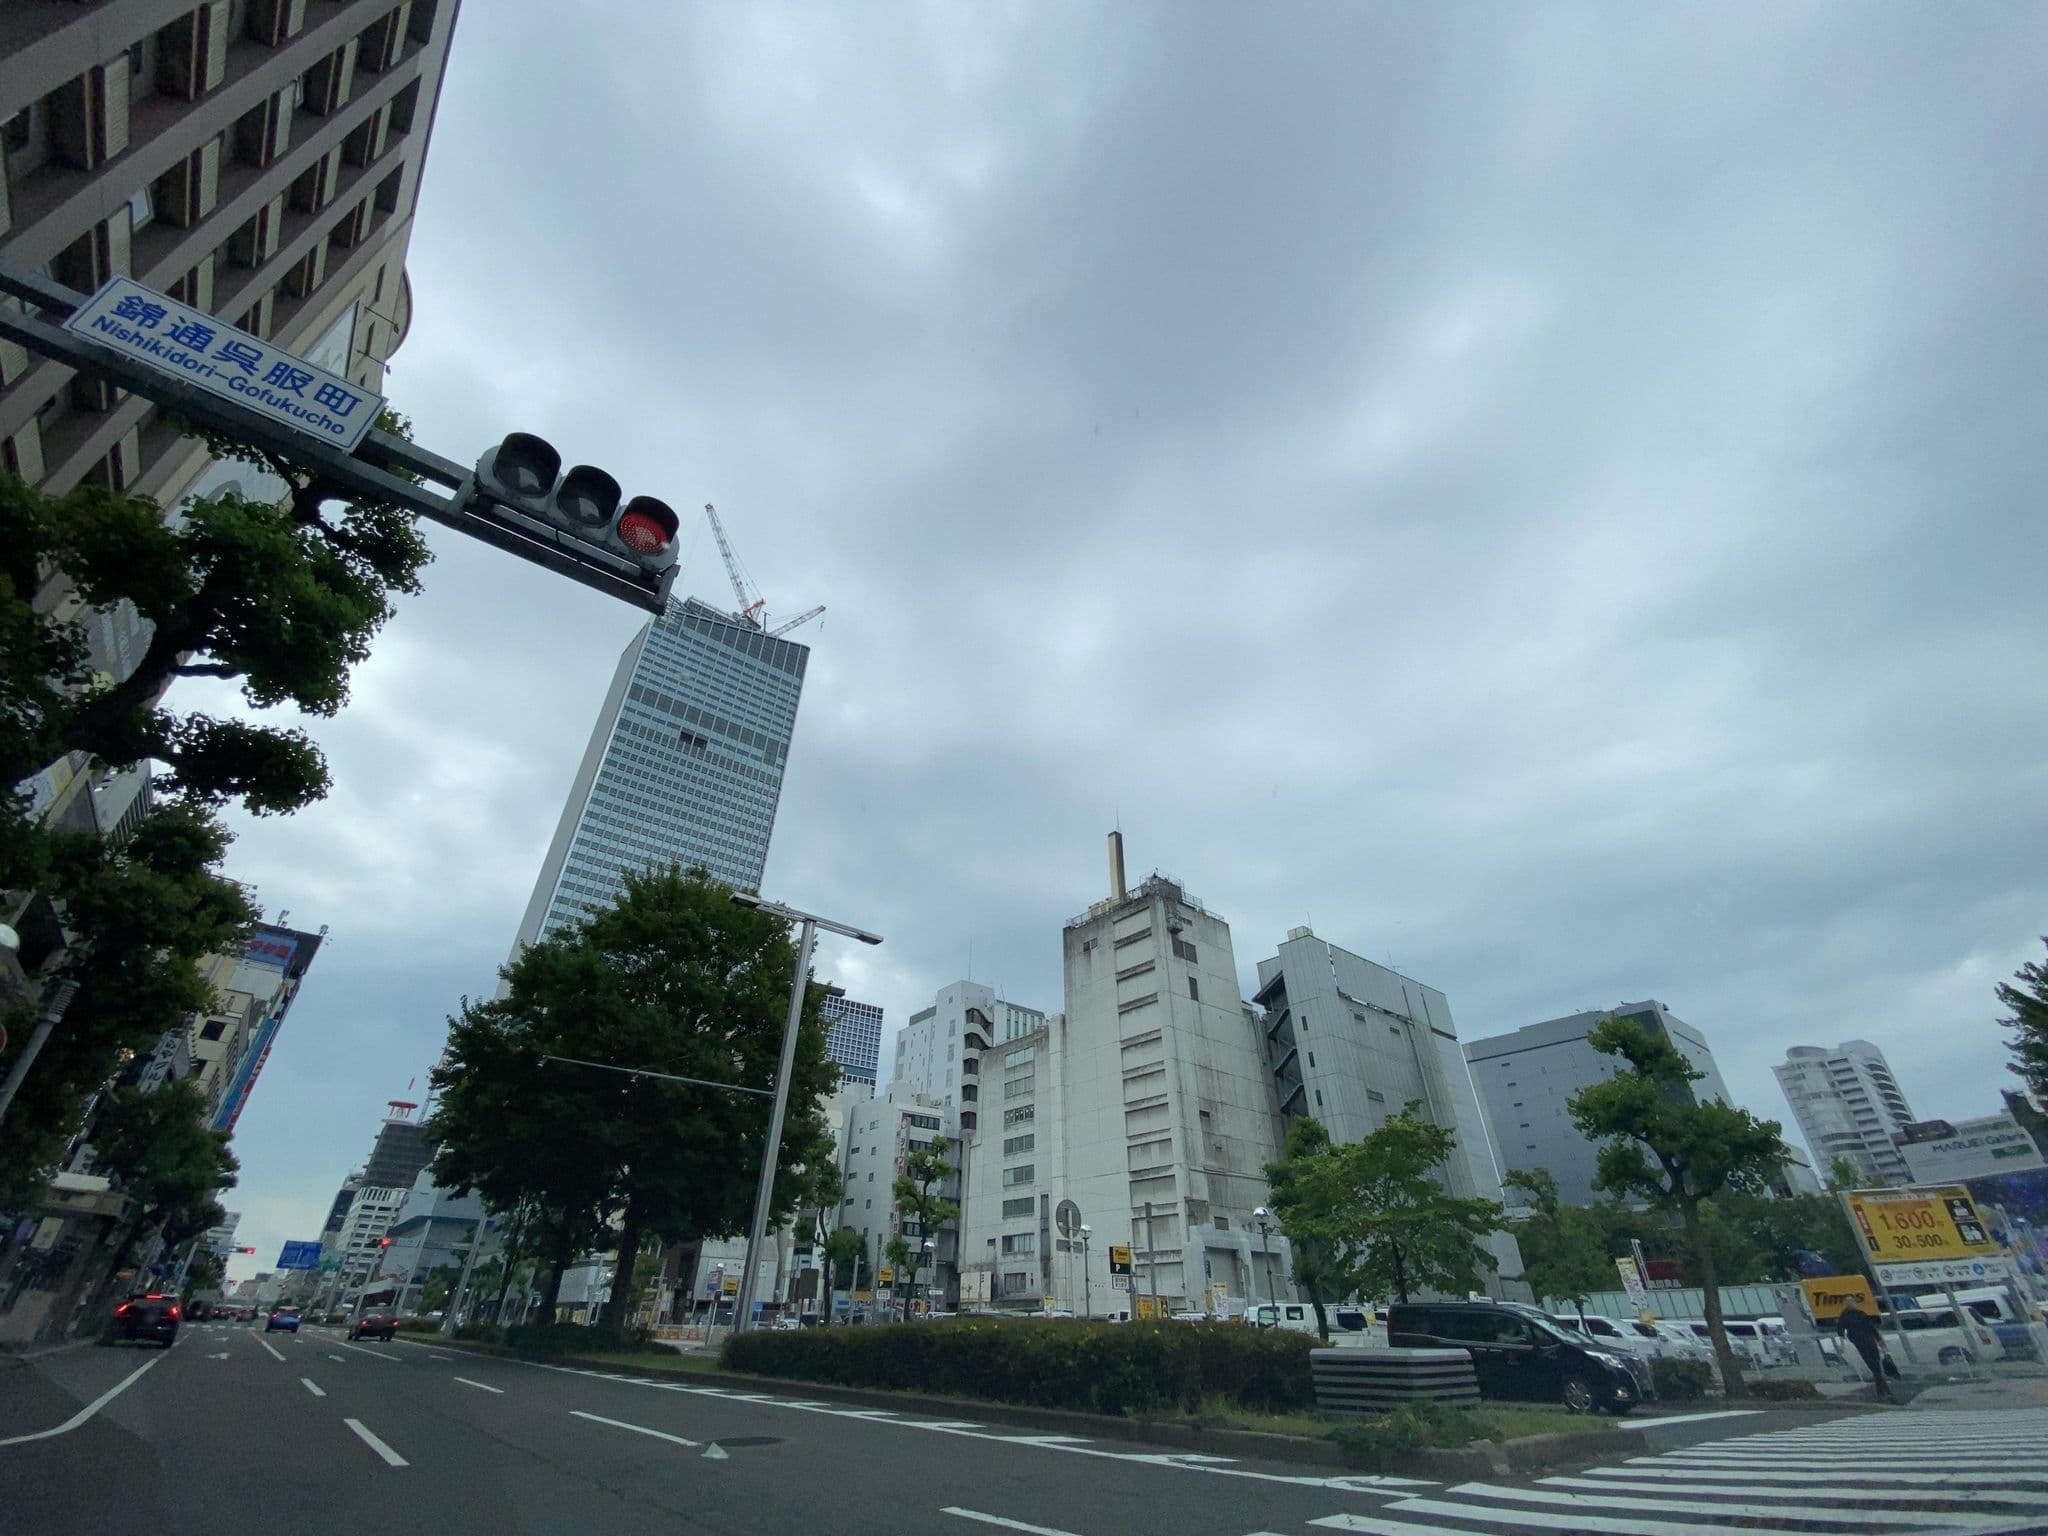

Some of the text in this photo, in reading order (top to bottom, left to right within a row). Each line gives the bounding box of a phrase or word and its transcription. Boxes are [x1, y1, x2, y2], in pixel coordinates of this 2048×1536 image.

[90, 315, 346, 436] Nishikidori-Gofukucho
[109, 295, 363, 417] 錦通呉服町
